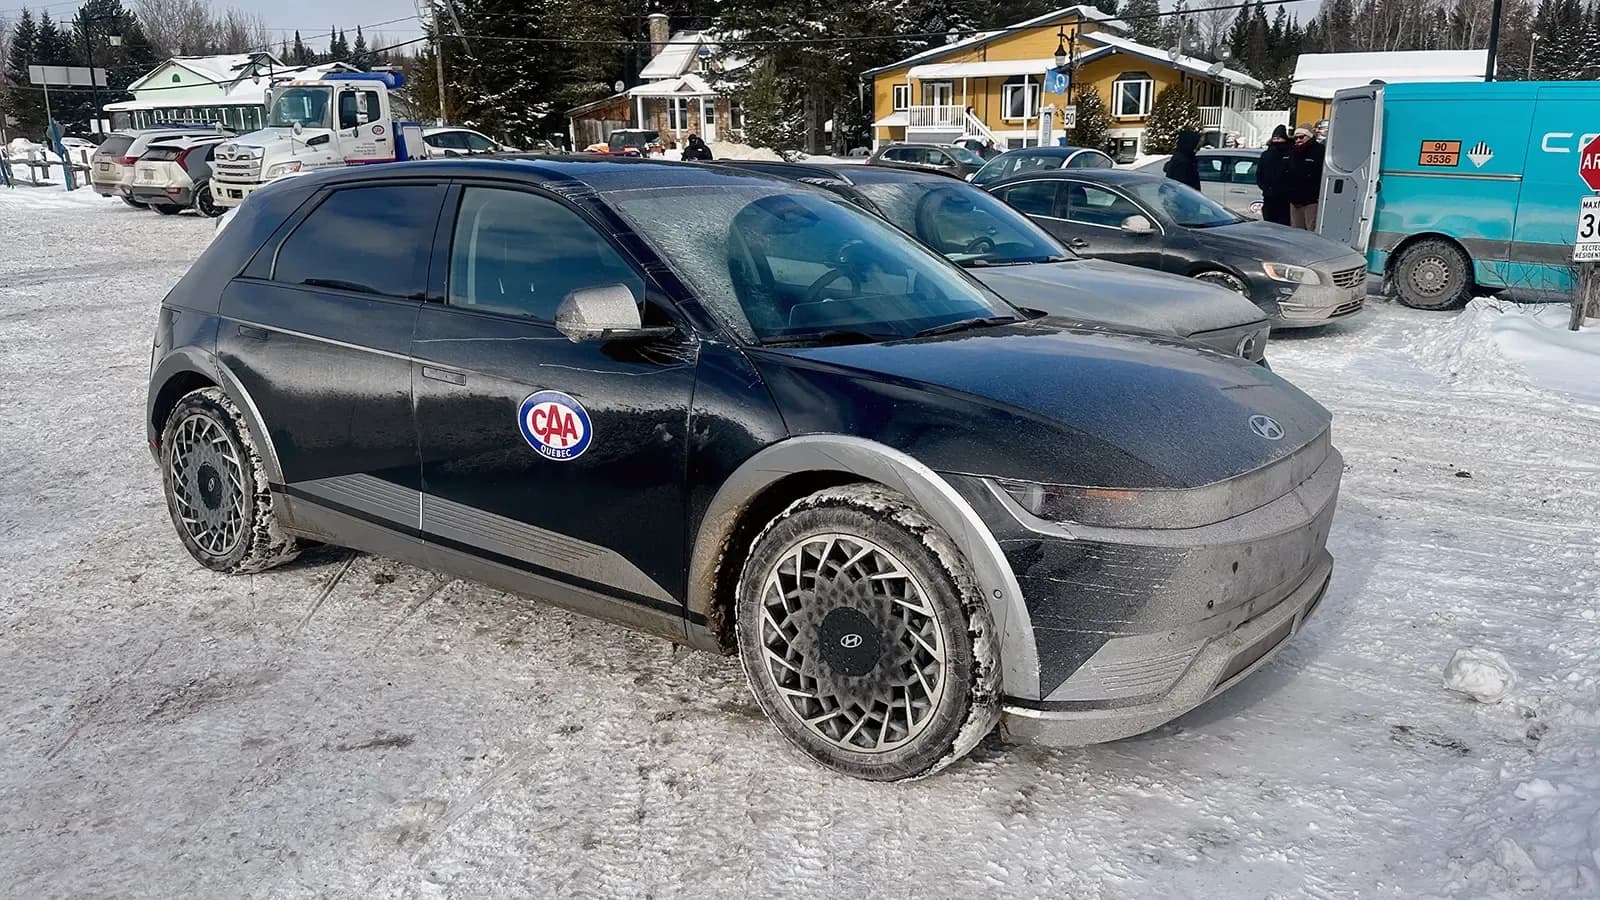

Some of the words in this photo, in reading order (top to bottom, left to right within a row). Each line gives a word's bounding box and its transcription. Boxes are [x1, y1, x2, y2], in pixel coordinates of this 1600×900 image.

[1065, 113, 1075, 126] 50
[1434, 142, 1447, 152] 90
[1426, 154, 1452, 164] 3536
[532, 404, 578, 447] CAA
